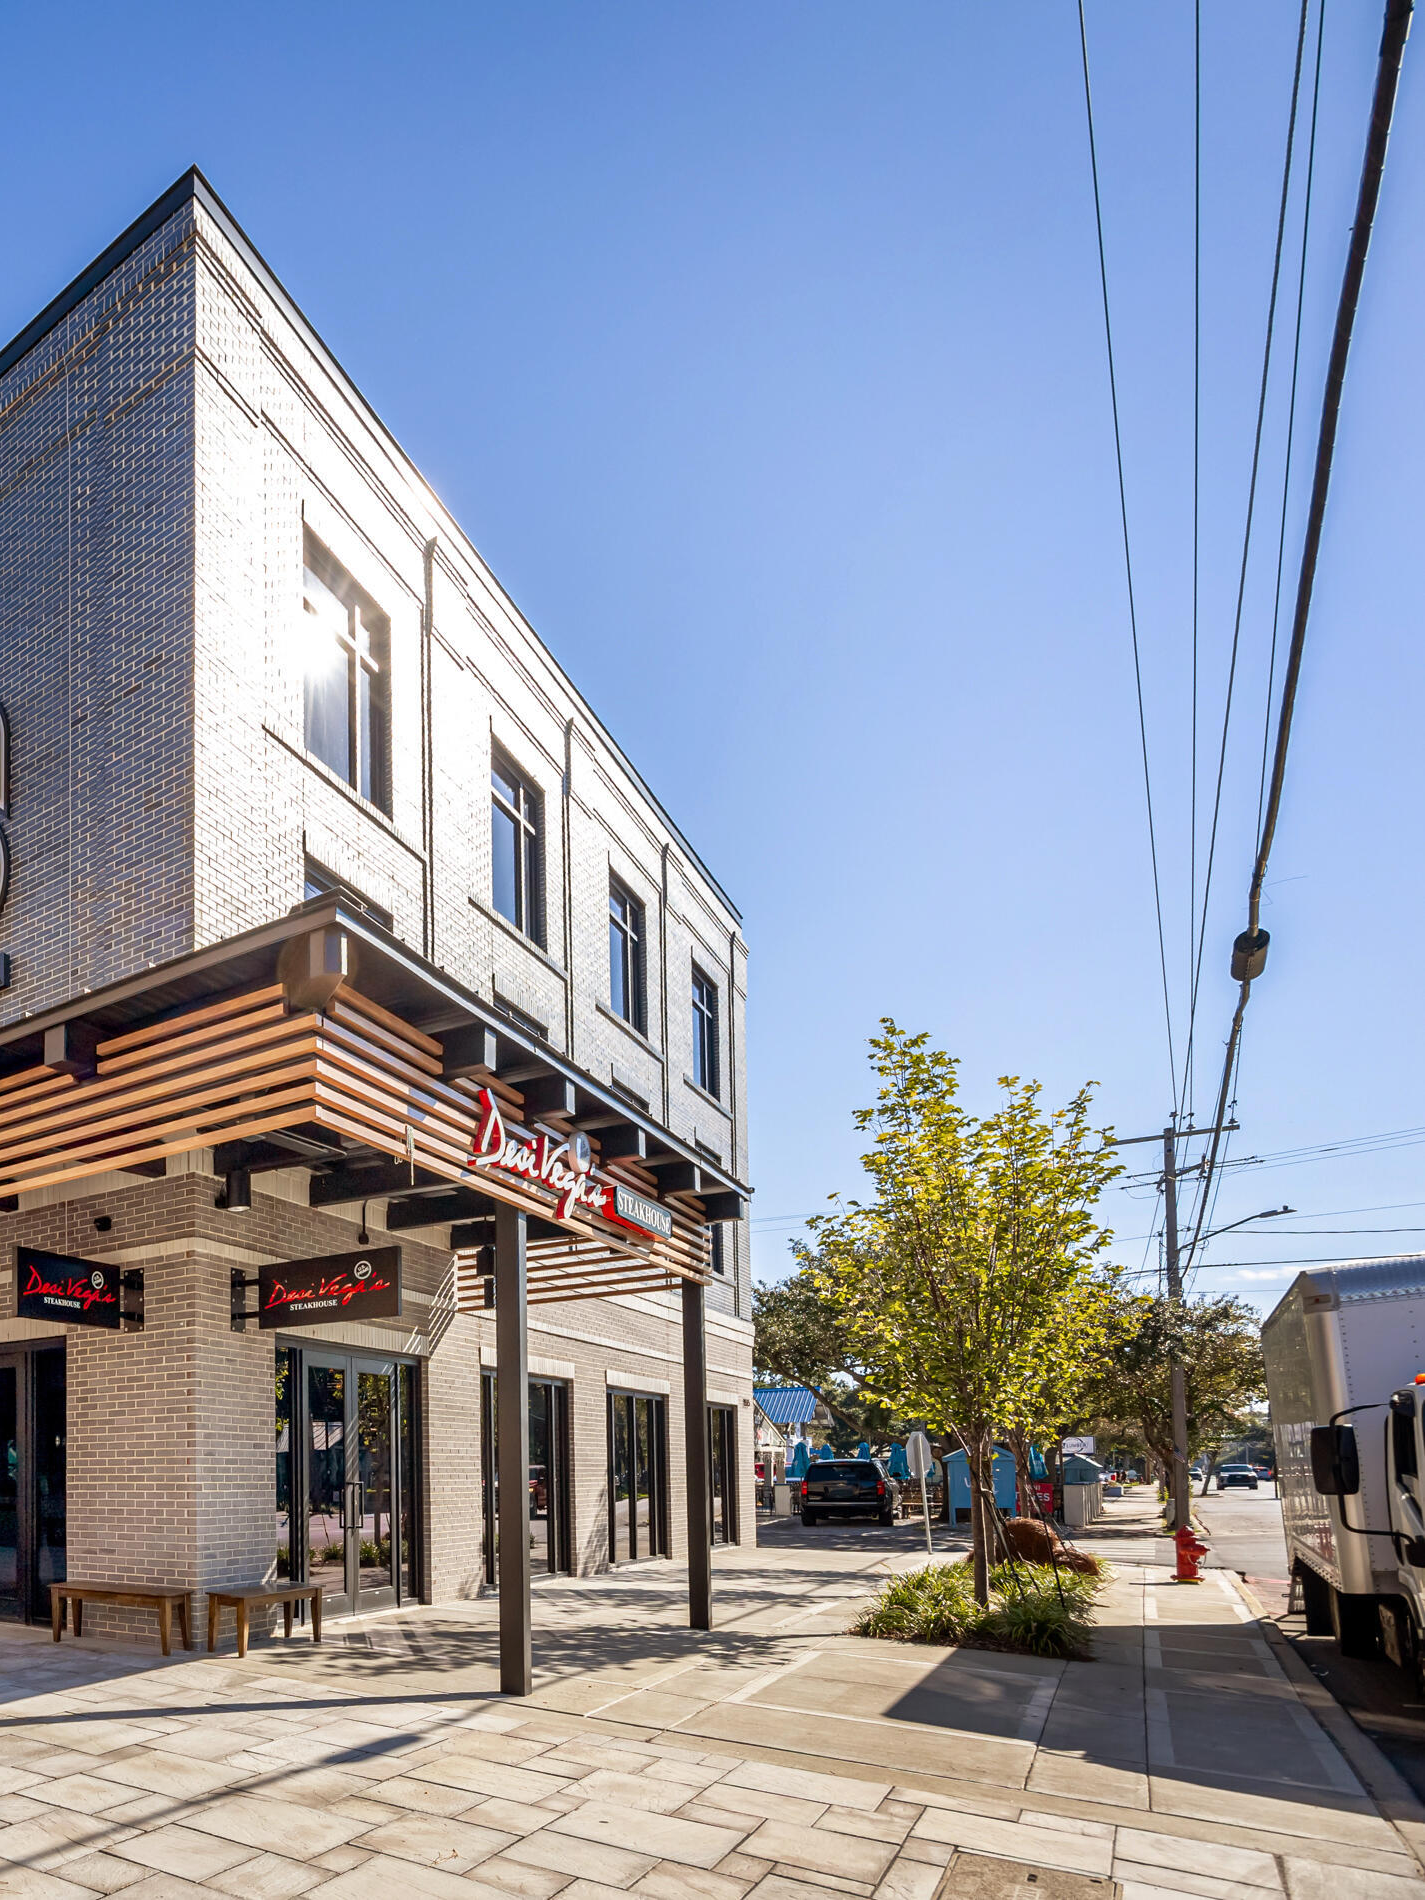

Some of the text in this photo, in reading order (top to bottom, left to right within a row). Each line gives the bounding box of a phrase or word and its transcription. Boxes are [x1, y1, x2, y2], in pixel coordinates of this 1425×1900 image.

[539, 1136, 607, 1219] Vega's
[617, 1190, 671, 1235] STEAKHOUSE
[23, 1265, 116, 1310] Desi Vega's
[43, 1296, 81, 1309] STEAKHOUSE
[264, 1272, 391, 1309] Desi Vega's
[290, 1299, 338, 1311] STEAKHOUSE
